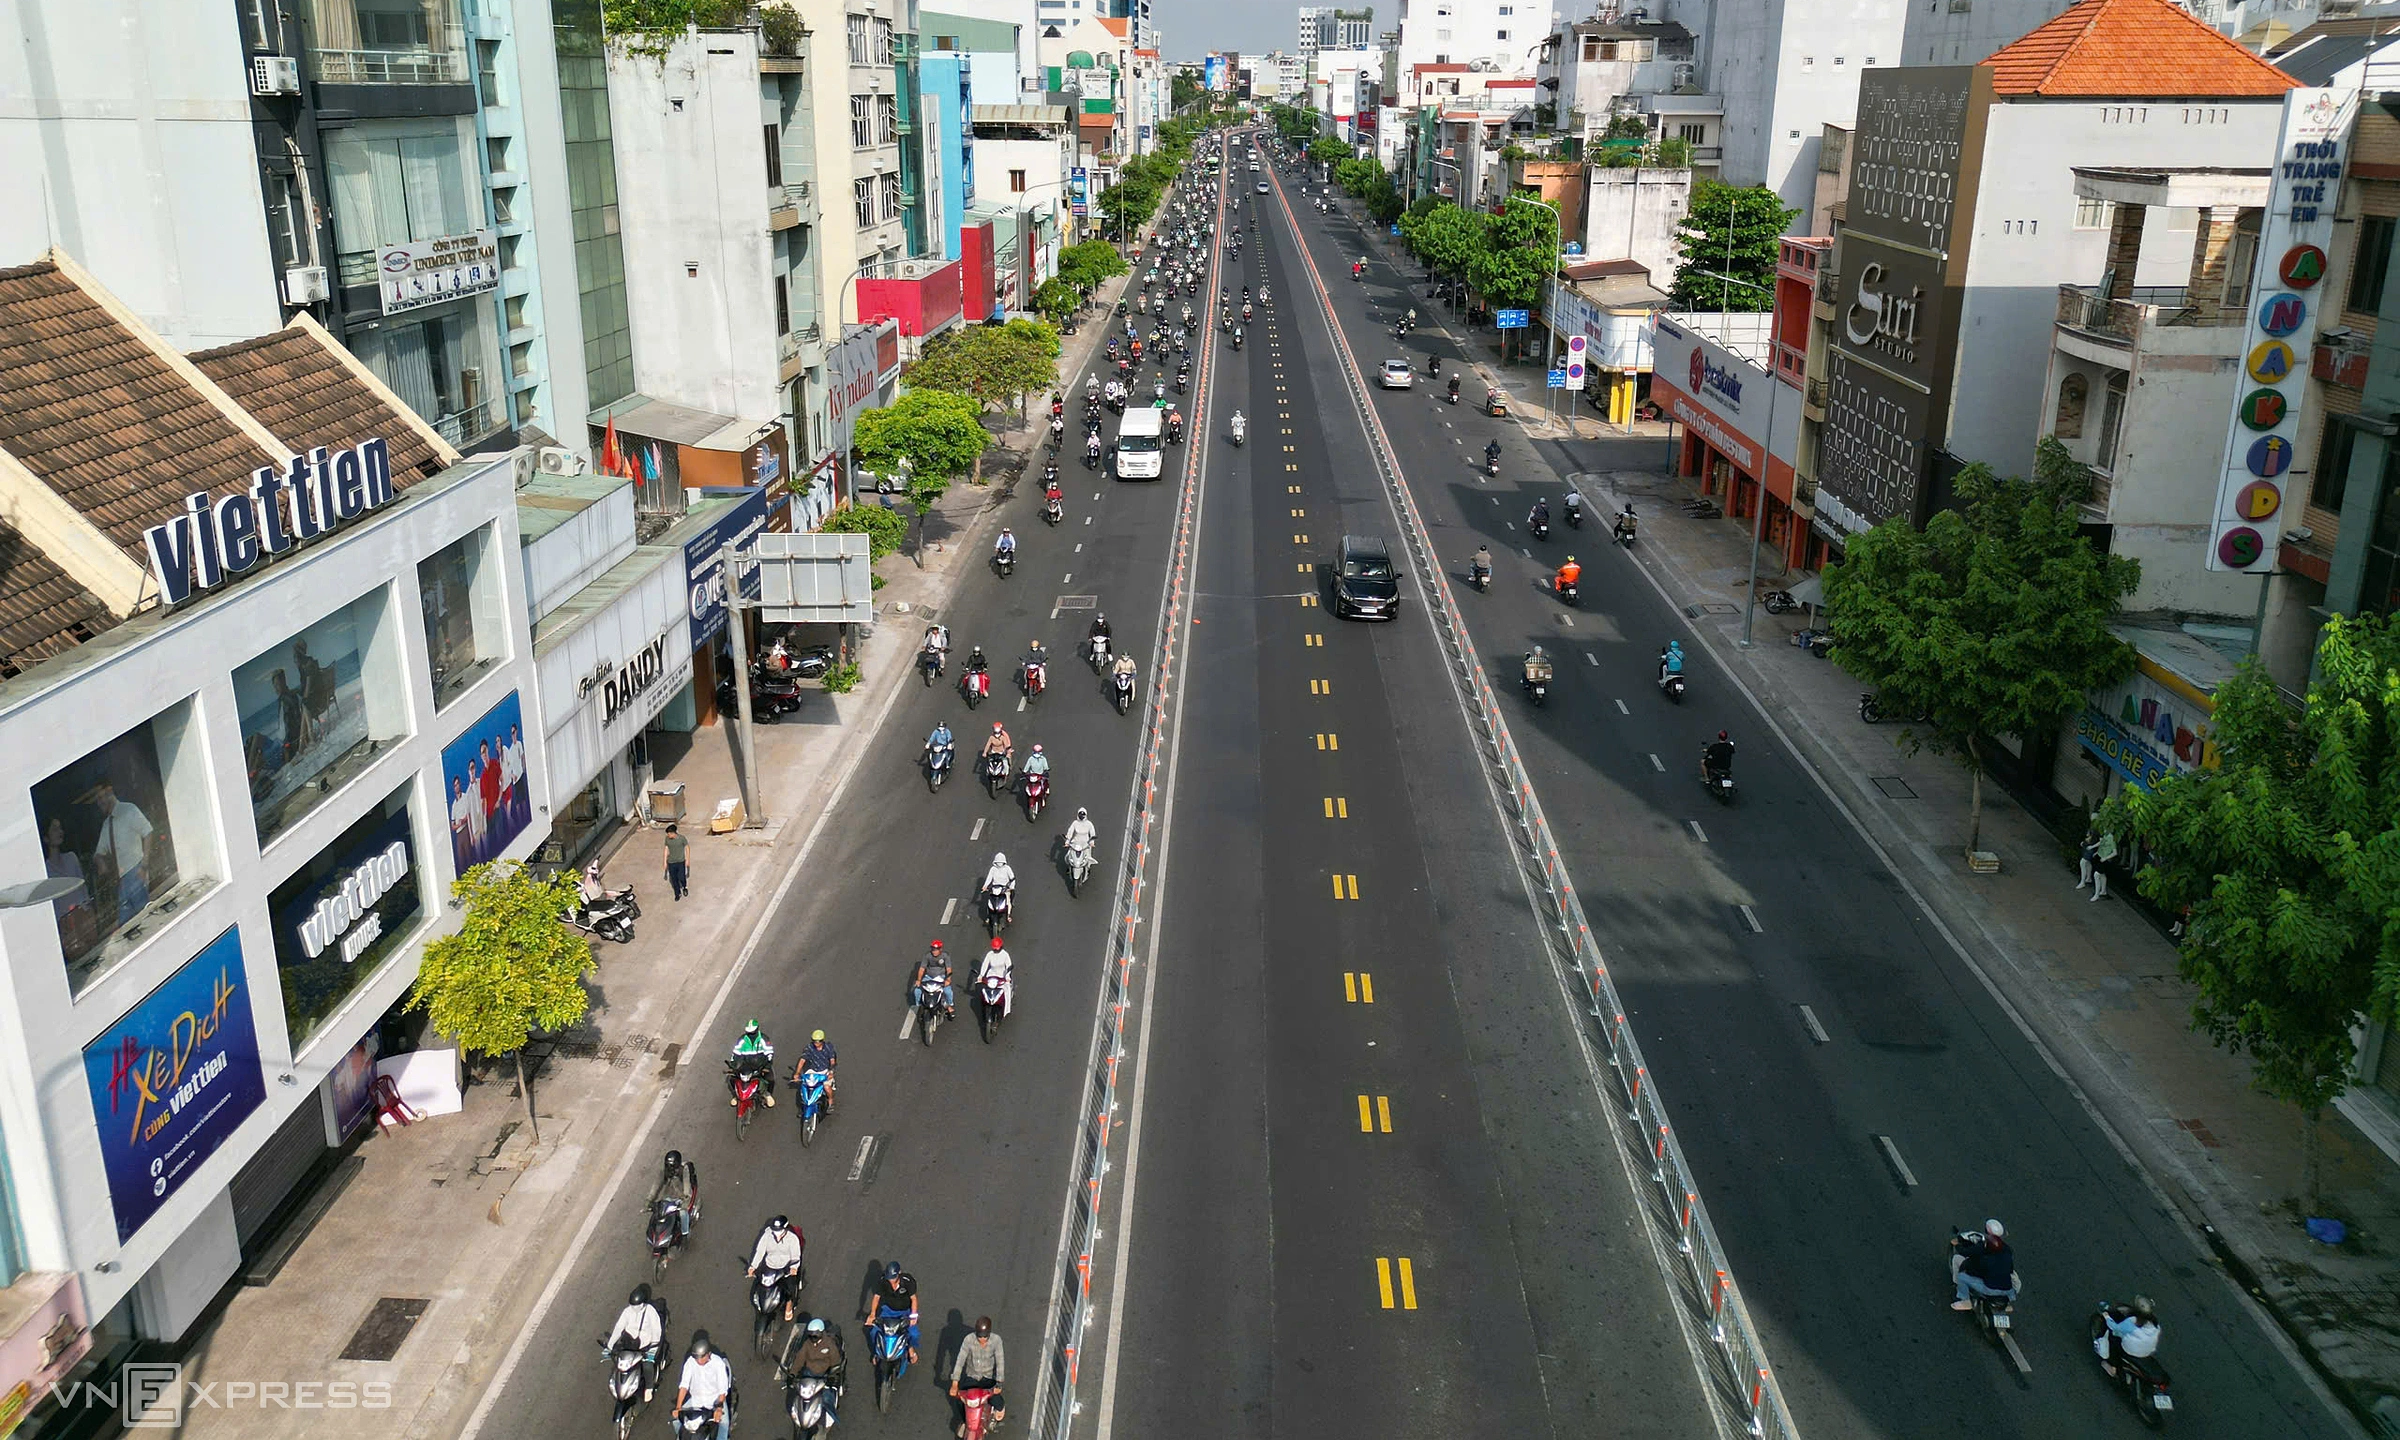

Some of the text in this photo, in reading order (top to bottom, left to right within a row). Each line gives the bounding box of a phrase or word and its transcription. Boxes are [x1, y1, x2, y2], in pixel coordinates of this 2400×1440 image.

[2294, 138, 2338, 159] THỜI
[2283, 162, 2341, 179] TRANG
[2292, 180, 2325, 203] TRẺ
[2290, 206, 2318, 223] EM
[413, 253, 456, 271] UNIMECH
[478, 245, 496, 260] NAM
[1847, 262, 1918, 345] Suri
[1875, 336, 1914, 363] STUDIO
[143, 437, 394, 605] viettien
[601, 632, 666, 720] DANDY
[299, 841, 408, 959] viettien
[169, 1050, 228, 1116] viettien
